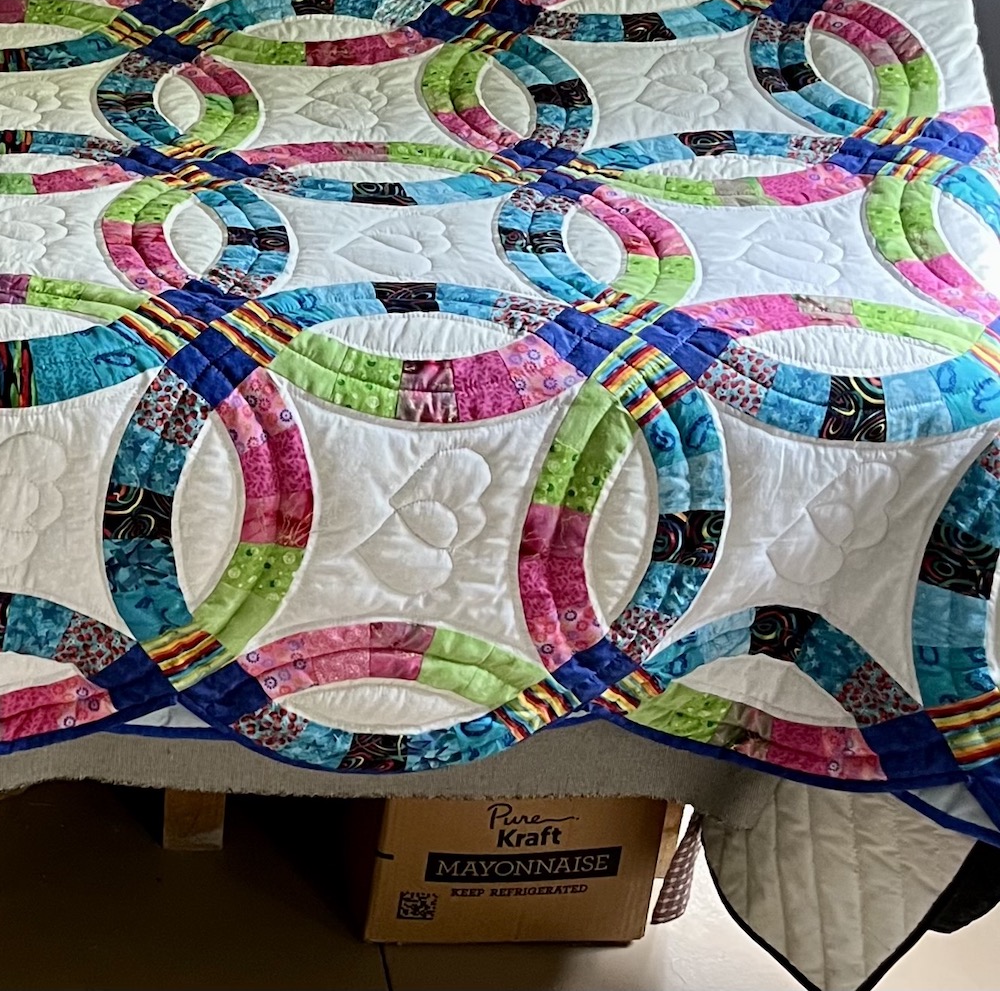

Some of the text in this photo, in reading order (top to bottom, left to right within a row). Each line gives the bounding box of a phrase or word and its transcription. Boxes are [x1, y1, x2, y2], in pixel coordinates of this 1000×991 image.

[487, 803, 579, 830] Pure
[497, 826, 562, 848] Kraft
[435, 854, 610, 877] MAYONNAISE
[451, 884, 588, 897] KEEP REFRIGERATED
